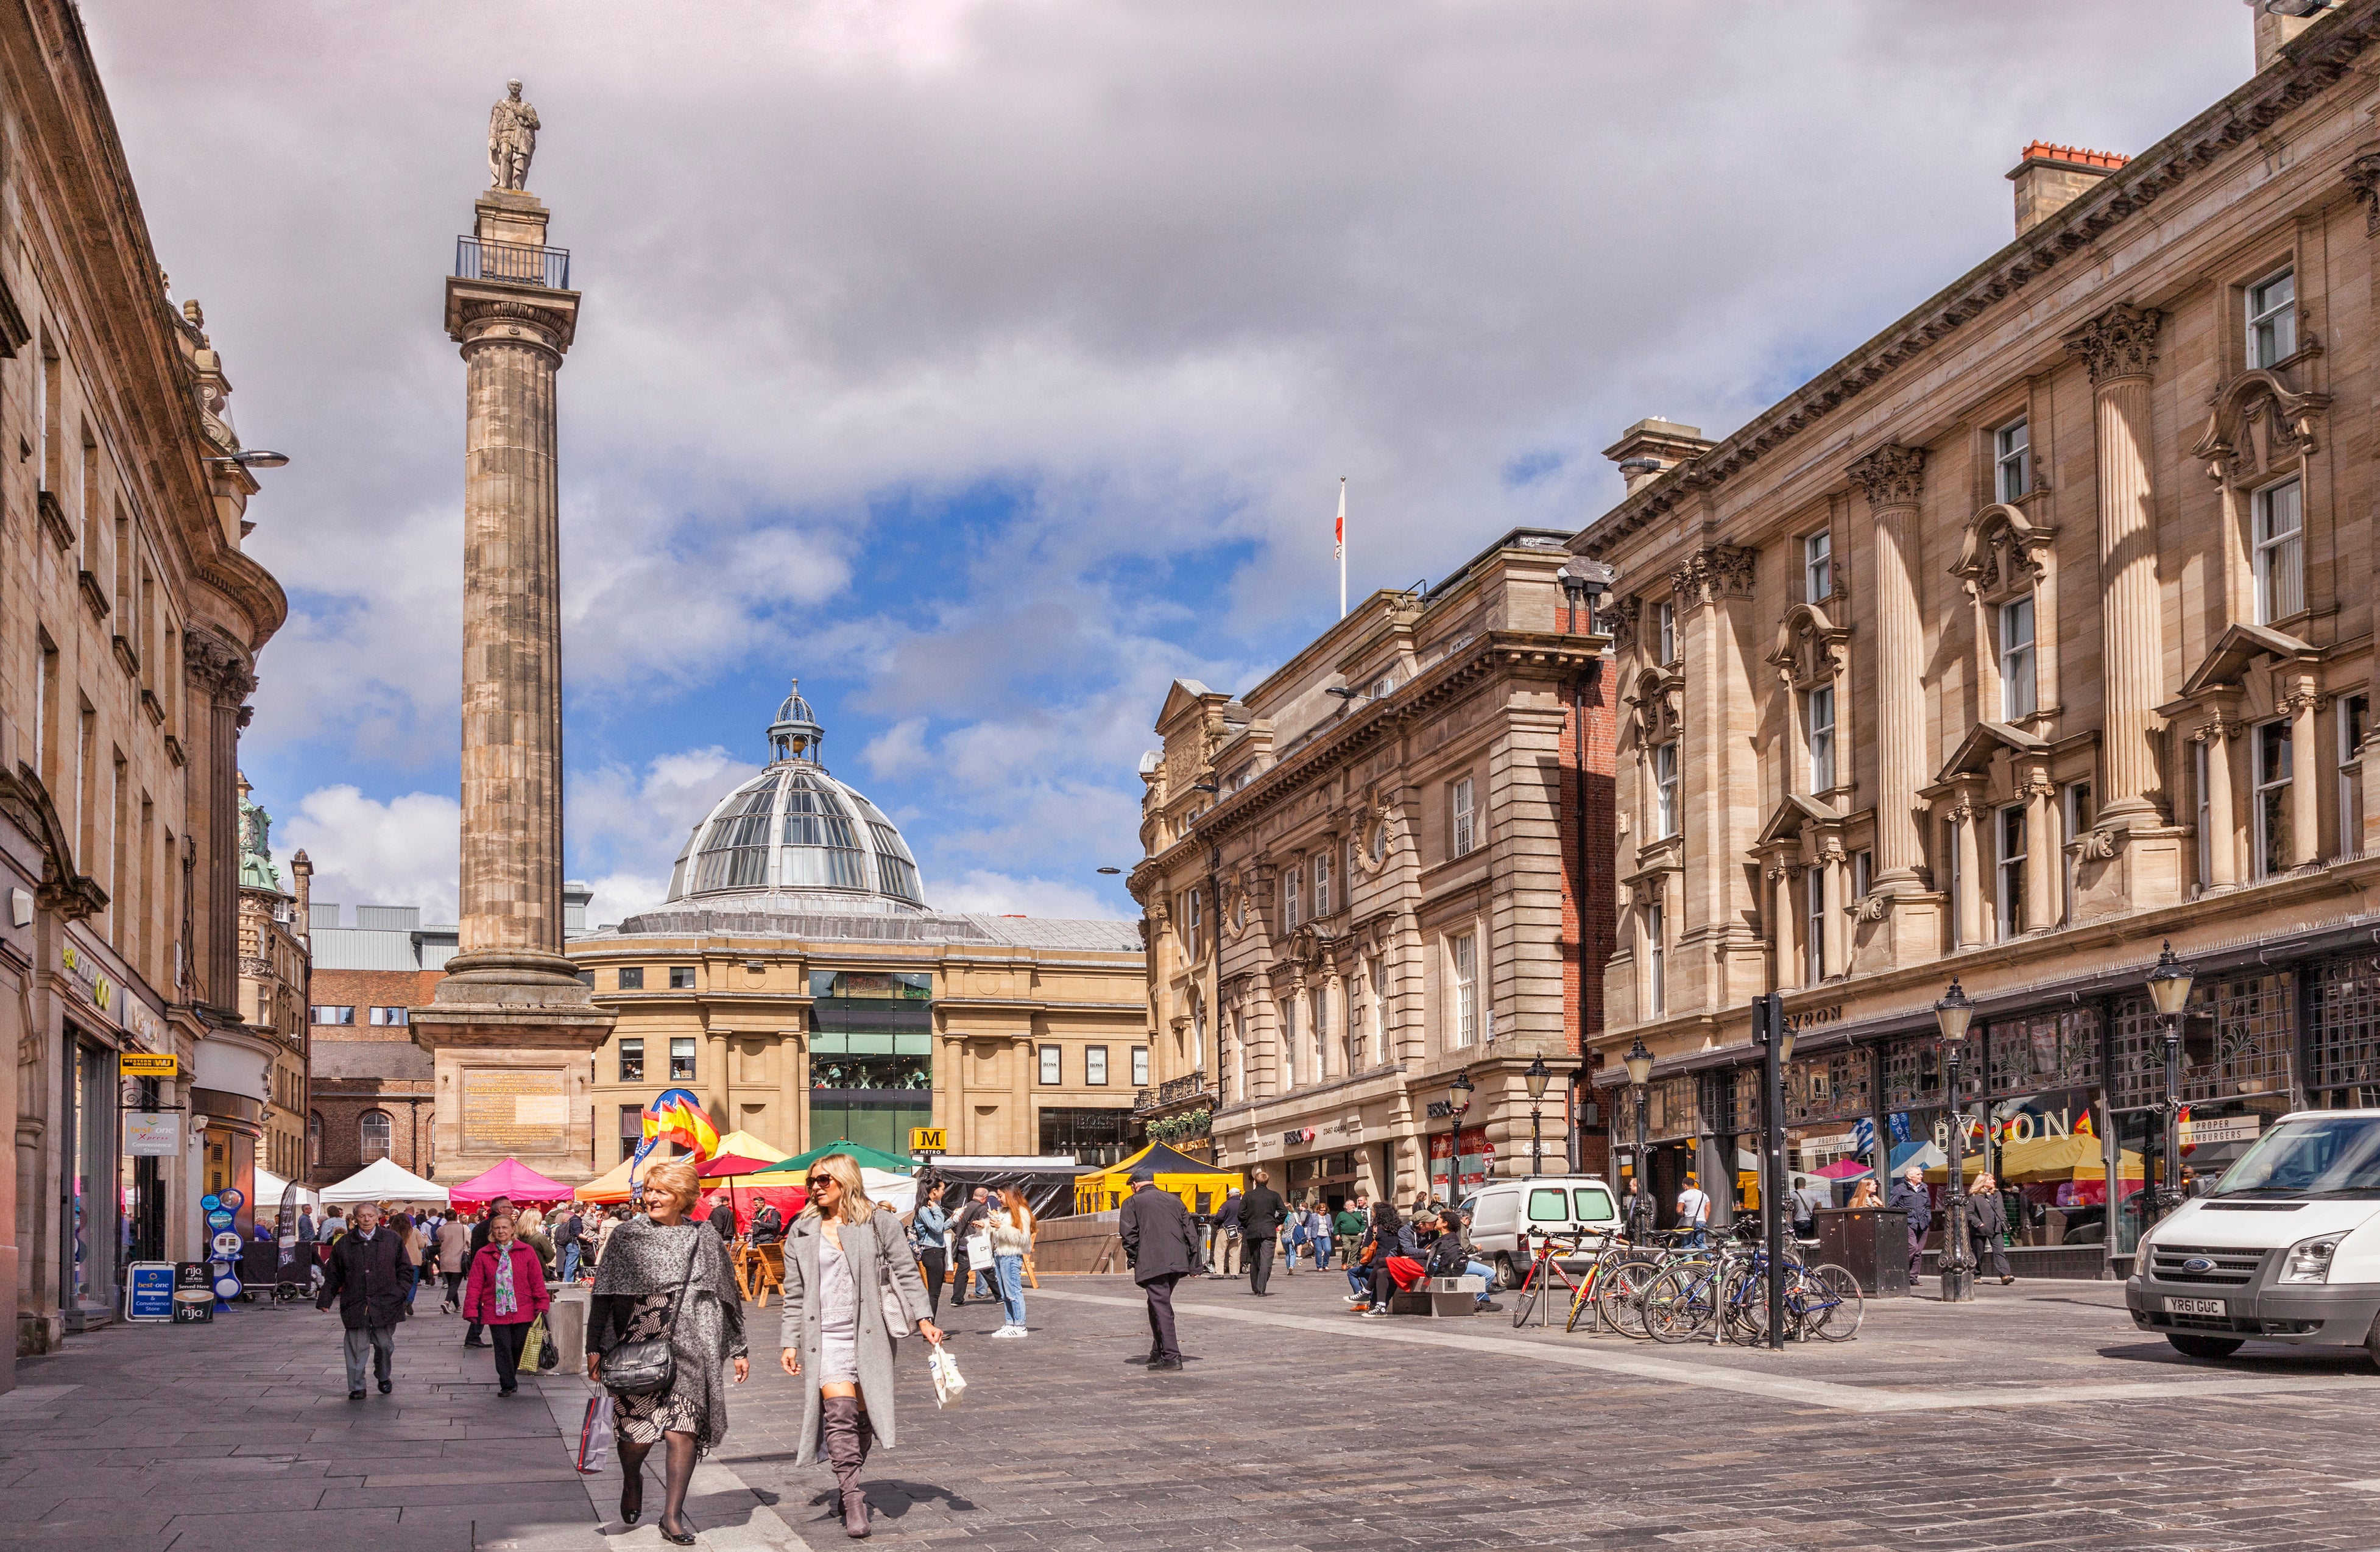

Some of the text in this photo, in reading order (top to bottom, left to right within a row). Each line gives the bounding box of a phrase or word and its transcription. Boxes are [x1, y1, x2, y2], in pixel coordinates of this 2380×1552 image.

[1792, 1005, 1841, 1029] YRON
[1077, 1115, 1114, 1126] BOSS
[2196, 1120, 2229, 1130] PROPER
[921, 1131, 941, 1146] M
[1284, 1129, 1304, 1145] HSBC
[1818, 1136, 1839, 1145] PROPER
[2184, 1130, 2241, 1143] HAMBURGERS
[1195, 1137, 1209, 1149] GREY
[1433, 1140, 1446, 1152] Free
[2188, 1260, 2203, 1269] Ford
[185, 1265, 202, 1277] rijo
[2170, 1299, 2218, 1313] YR61 GUC
[182, 1306, 203, 1319] rijo
